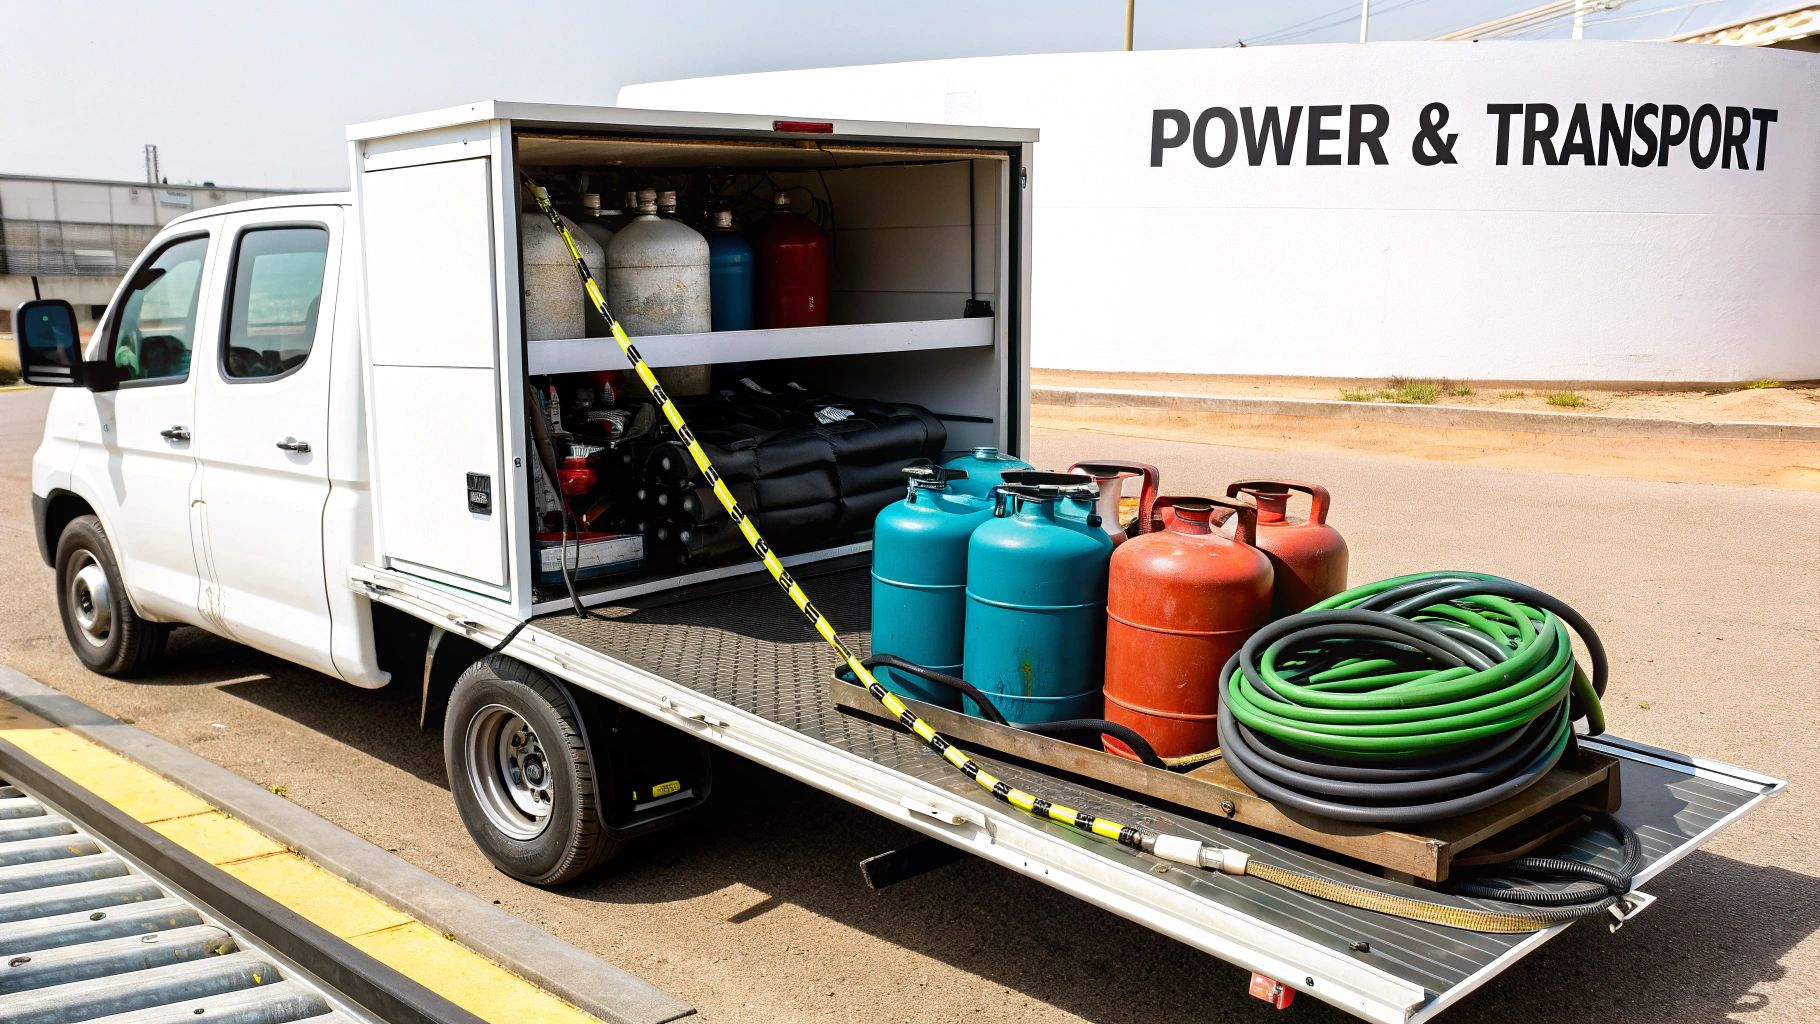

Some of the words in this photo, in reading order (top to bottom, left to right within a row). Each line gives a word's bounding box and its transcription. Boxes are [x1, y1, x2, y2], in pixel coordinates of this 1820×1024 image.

[1150, 104, 1389, 168] POWER
[1411, 102, 1458, 166] &
[1486, 102, 1778, 170] TRANSPORT
